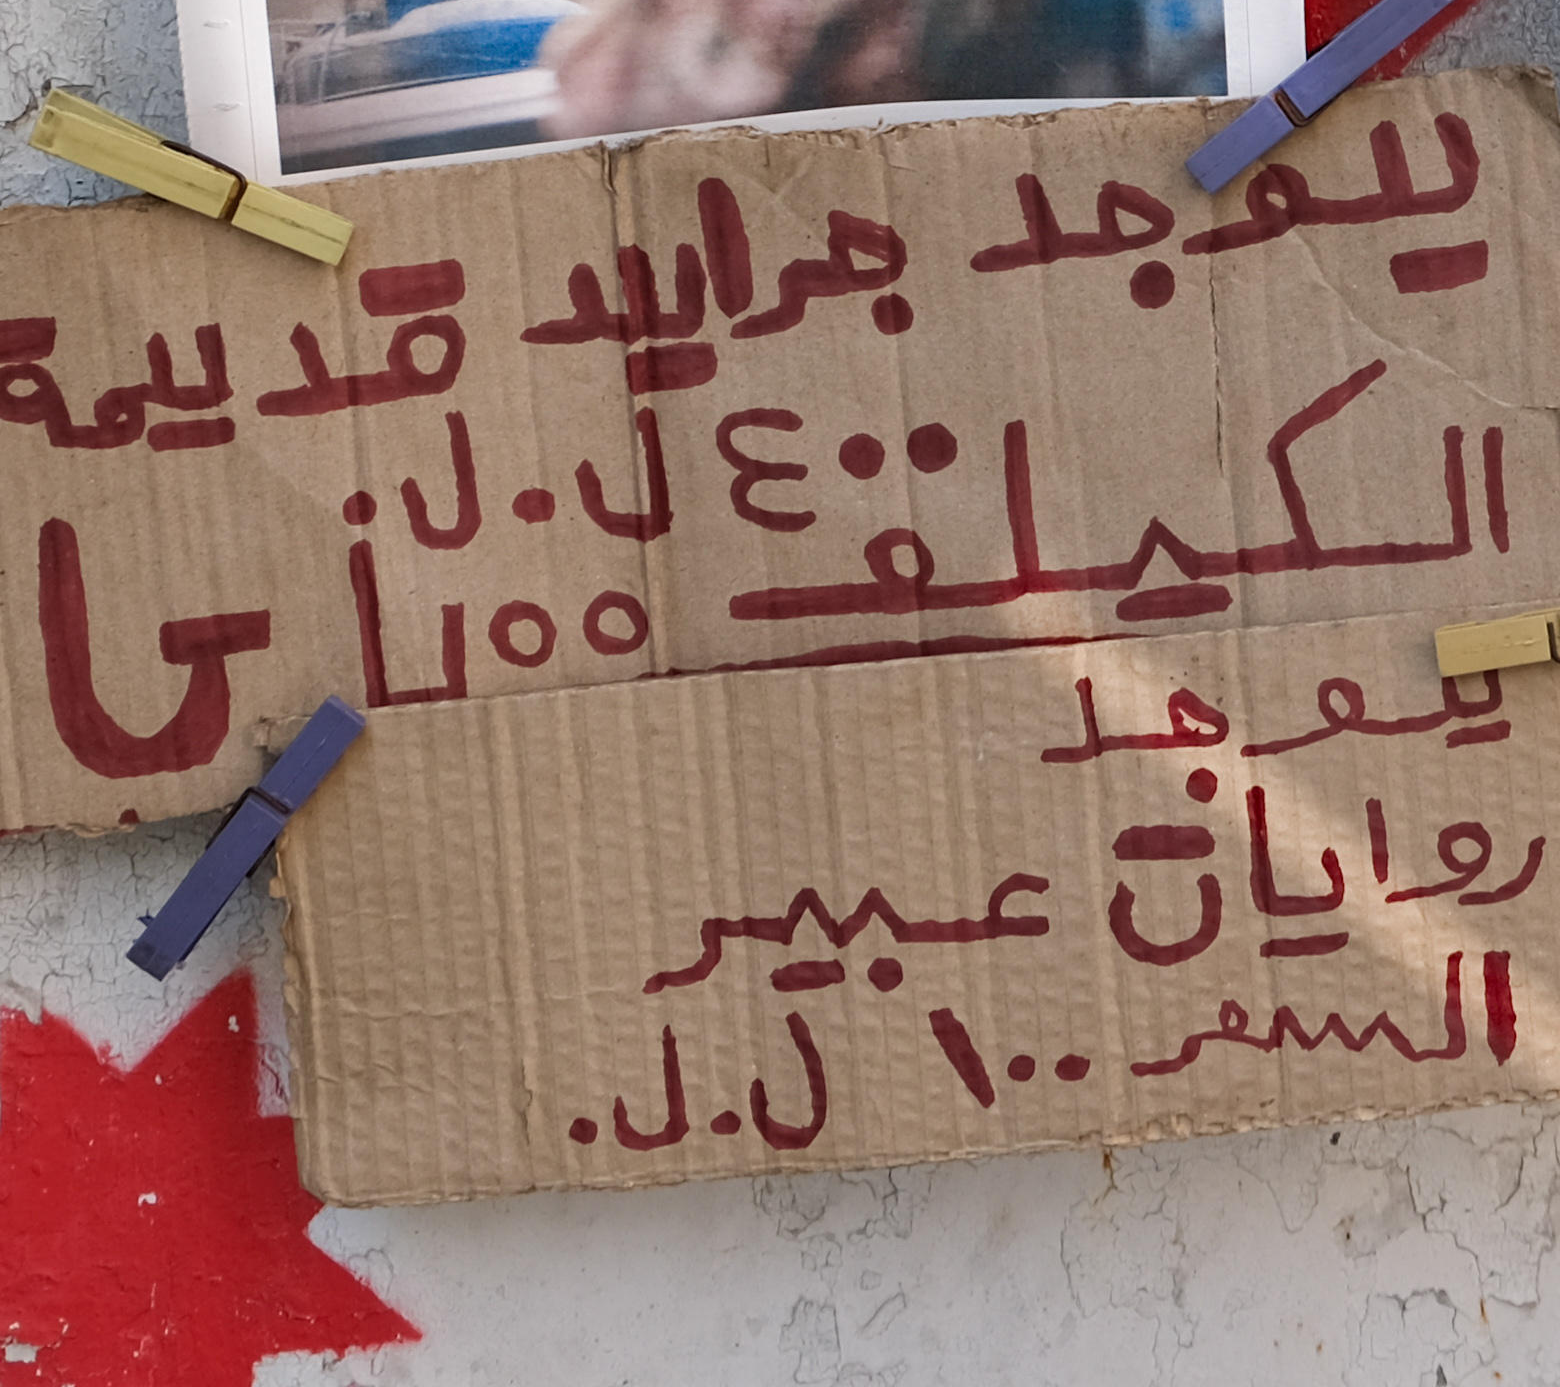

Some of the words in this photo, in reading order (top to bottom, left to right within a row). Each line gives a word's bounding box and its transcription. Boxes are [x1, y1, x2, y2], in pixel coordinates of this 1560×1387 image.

[520, 176, 909, 394] جرايد
[643, 872, 1050, 994] عبير
[1109, 783, 1546, 966] روايات
[1130, 951, 1518, 1078] السعر
